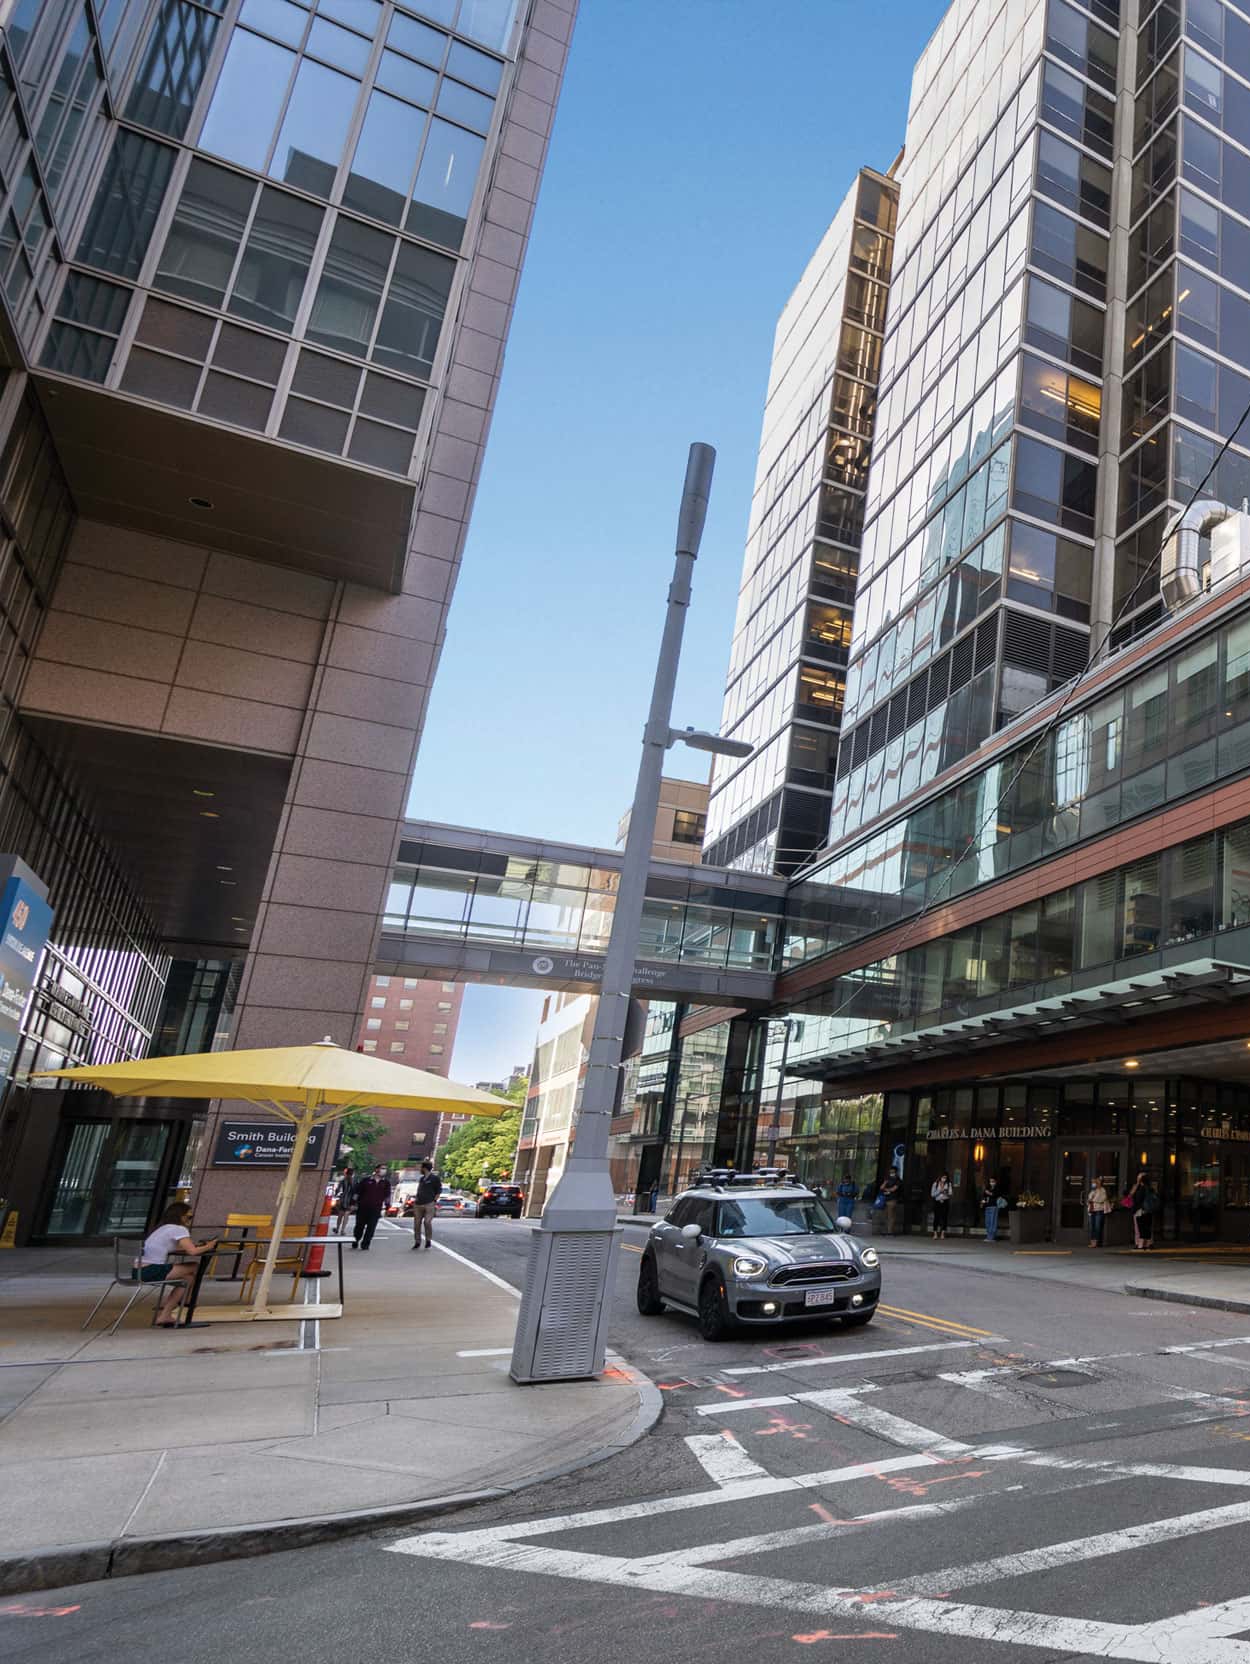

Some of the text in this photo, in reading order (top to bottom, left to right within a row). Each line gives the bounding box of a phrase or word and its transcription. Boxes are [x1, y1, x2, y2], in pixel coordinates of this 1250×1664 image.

[227, 1130, 317, 1144] Smith Buildg
[926, 1128, 960, 1140] CHARLES
[970, 1127, 996, 1138] DANA
[999, 1126, 1052, 1138] BUILDING
[255, 1145, 295, 1153] Dana-Far
